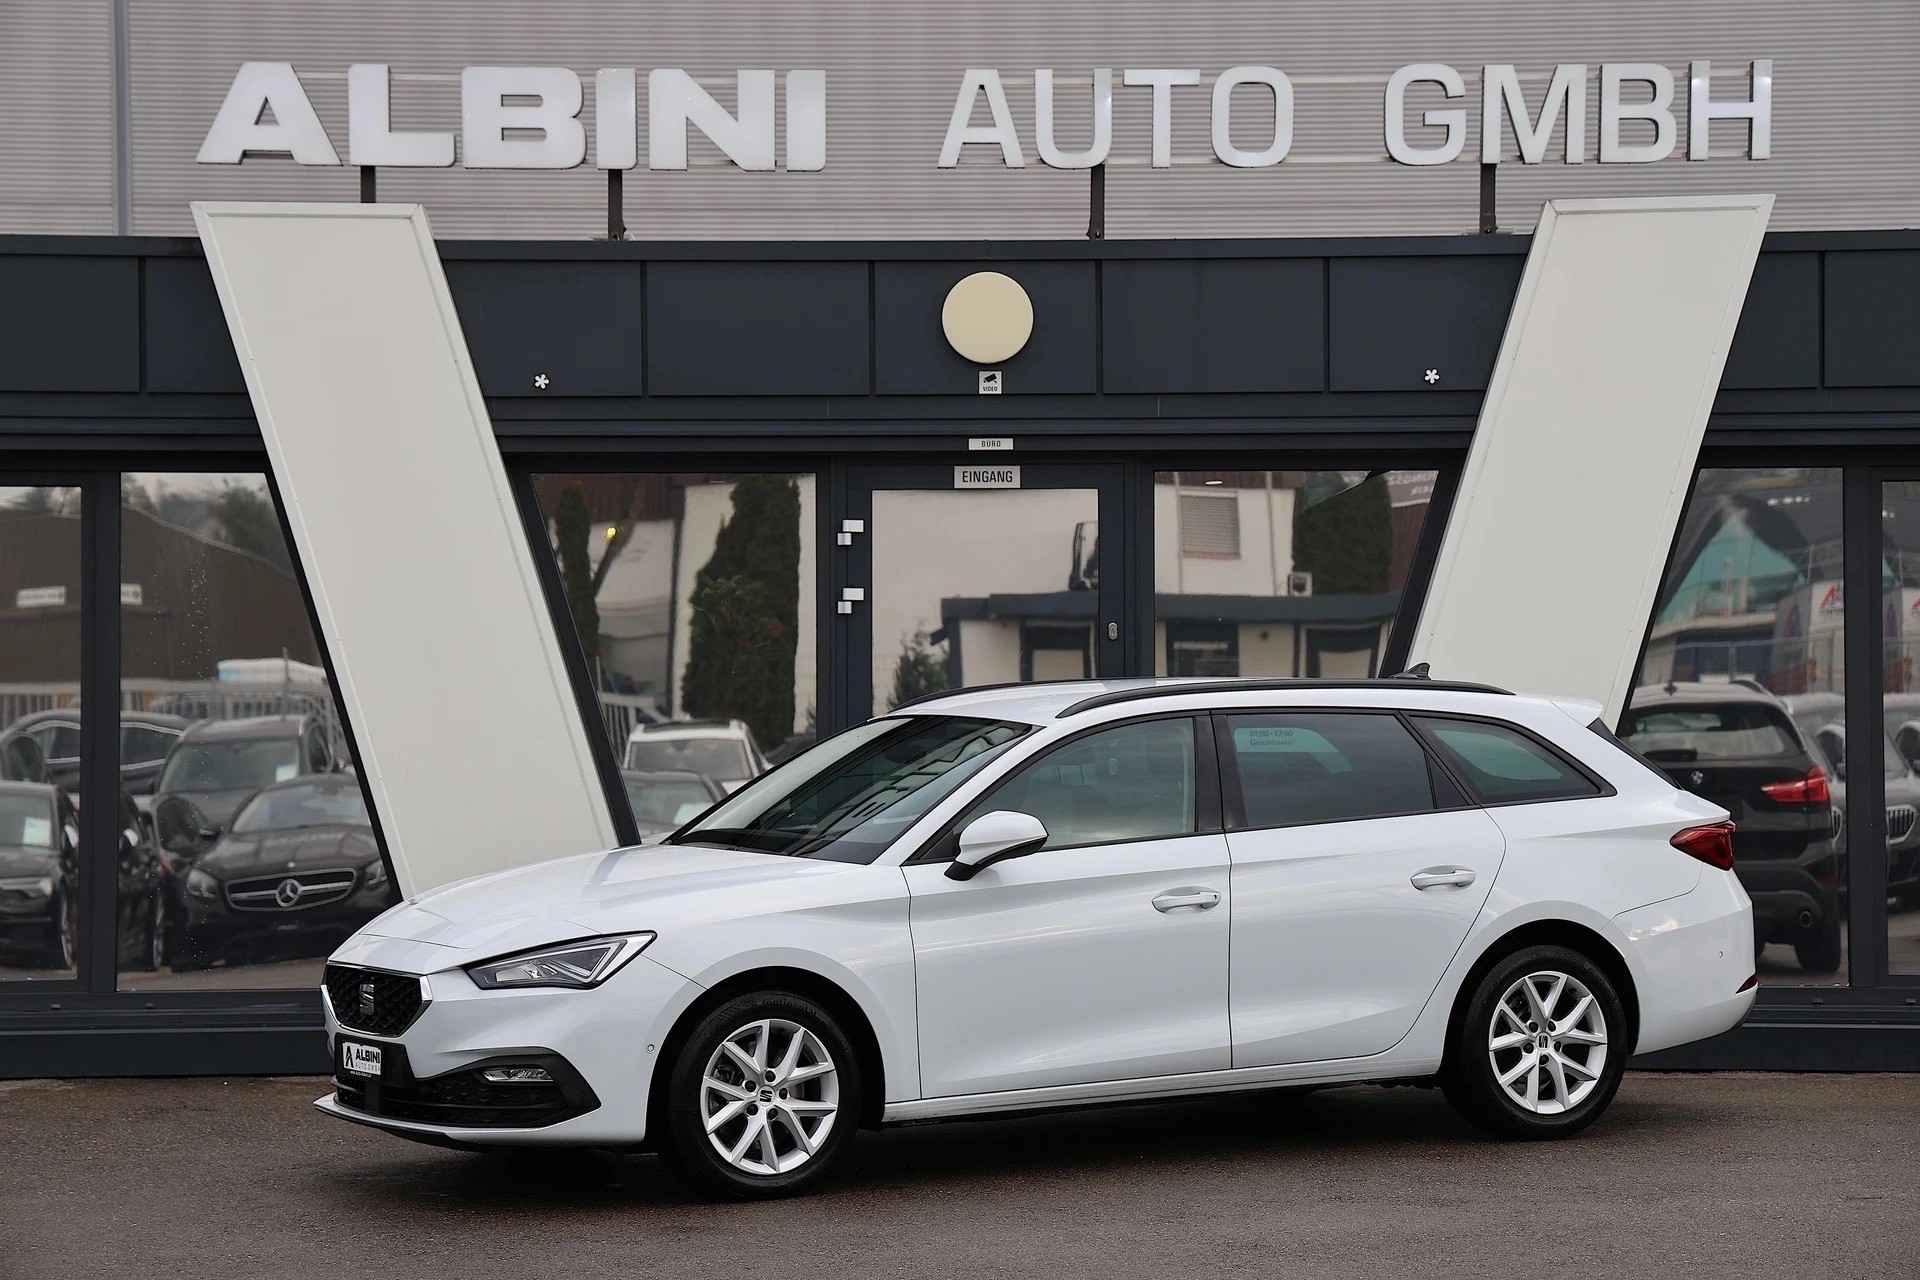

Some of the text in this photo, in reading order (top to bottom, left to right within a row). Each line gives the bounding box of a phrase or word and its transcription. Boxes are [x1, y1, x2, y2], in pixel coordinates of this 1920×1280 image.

[197, 59, 1773, 172] ALBINI AUTO GMBH
[981, 439, 1001, 448] BÜRO
[962, 470, 1013, 483] EINGANG
[355, 1048, 380, 1063] ALBINI
